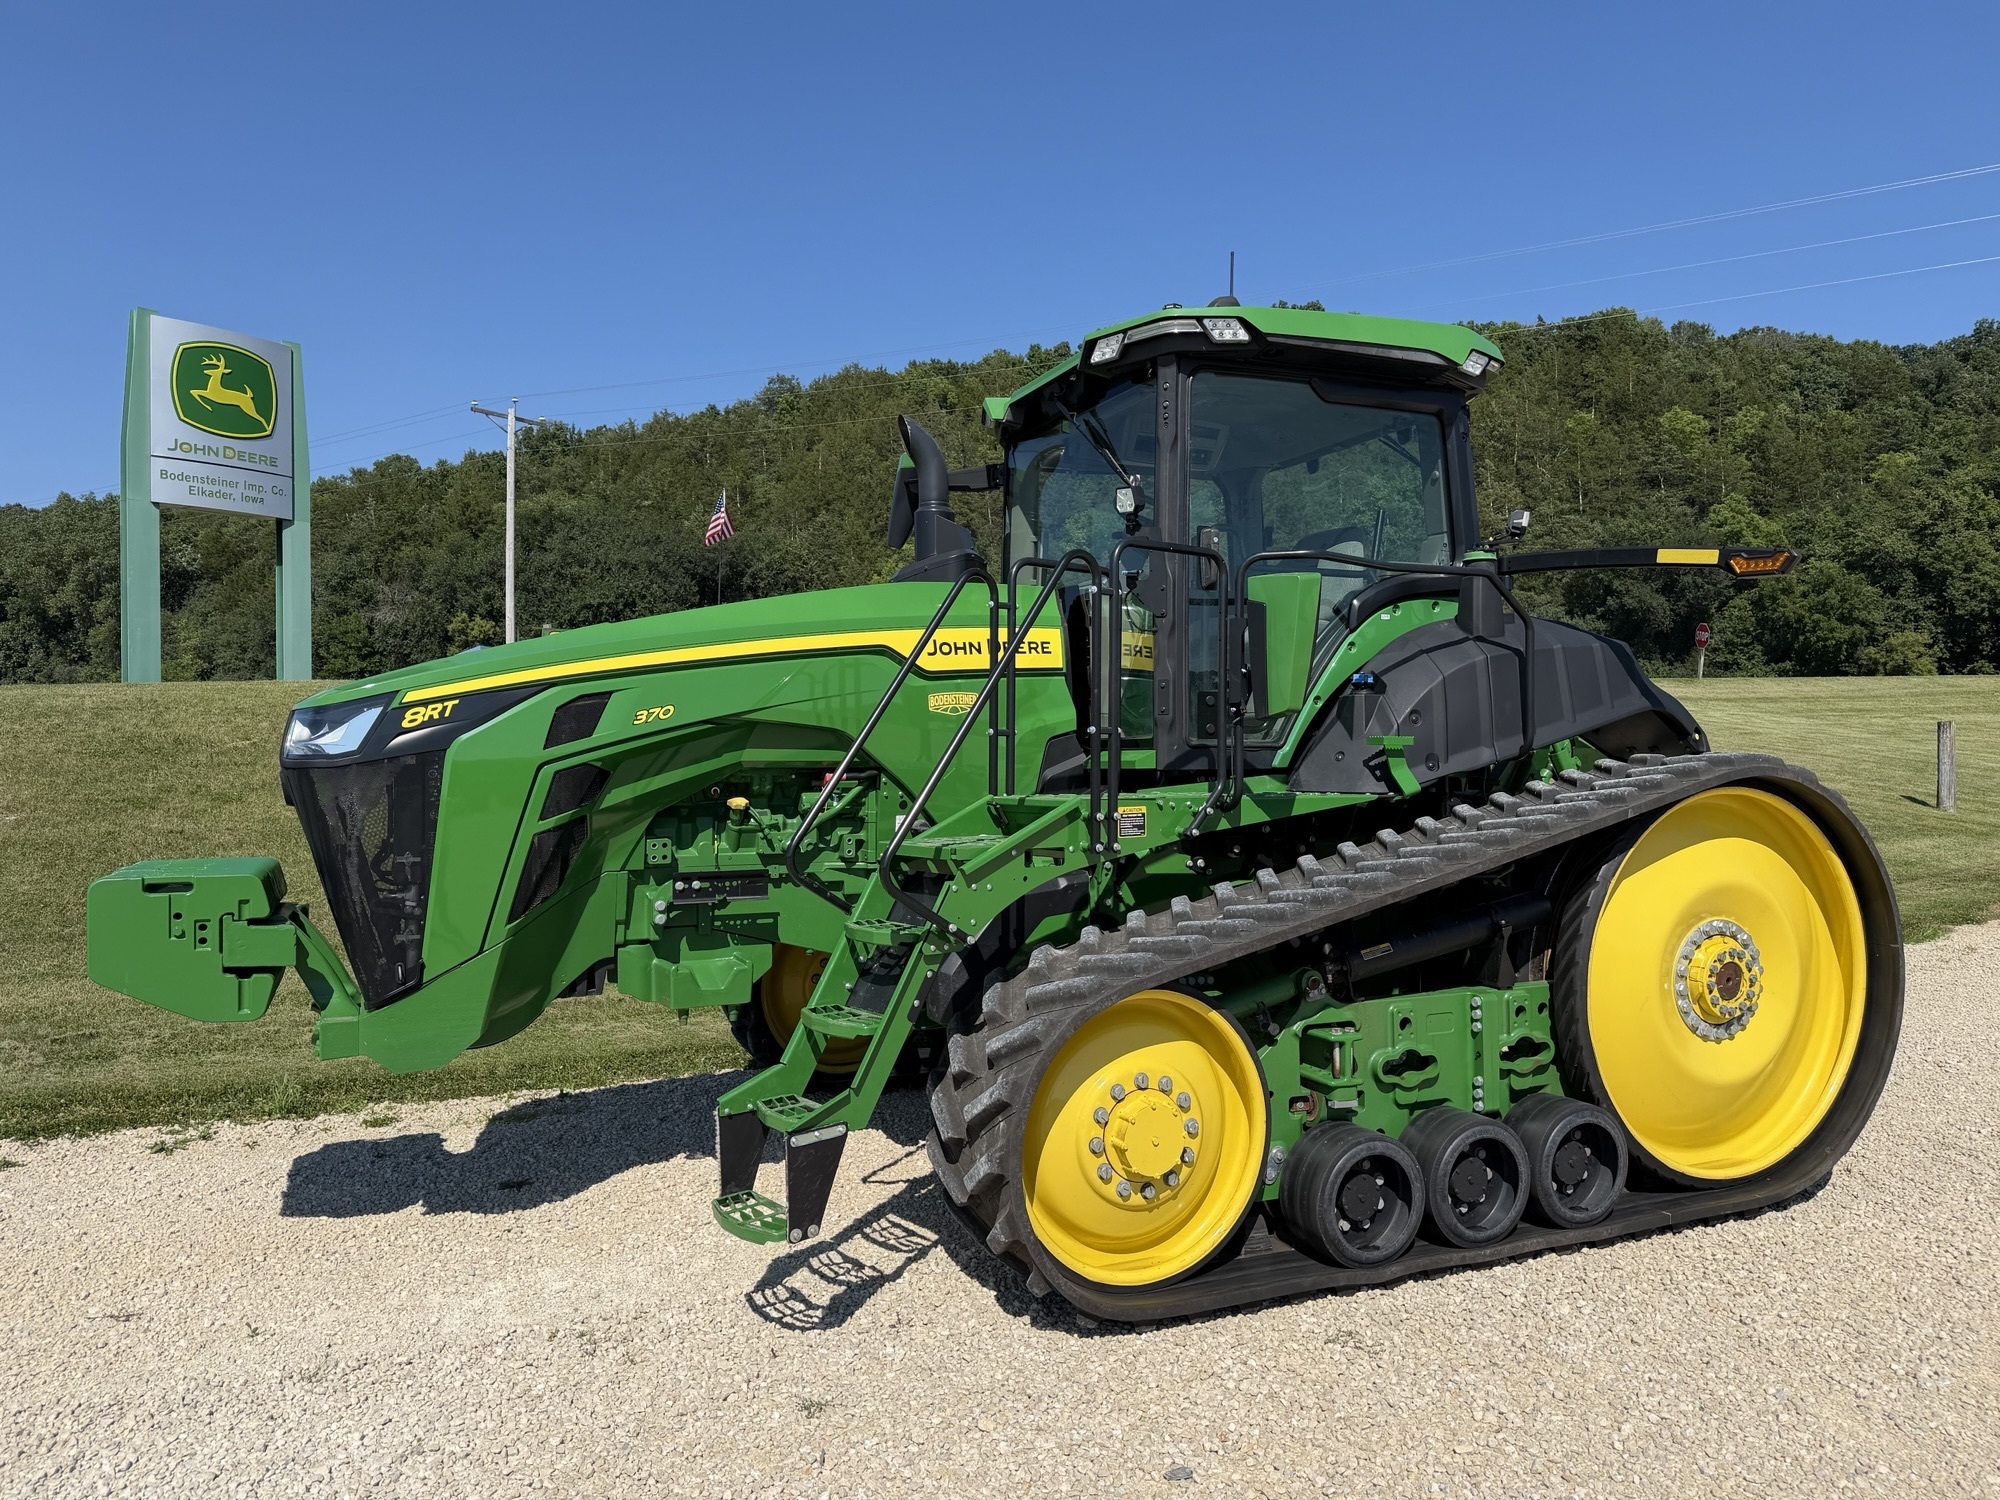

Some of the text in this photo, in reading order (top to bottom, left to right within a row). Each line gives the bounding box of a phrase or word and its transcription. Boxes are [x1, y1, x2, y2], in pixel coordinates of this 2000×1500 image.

[168, 438, 279, 468] JOHN DEERE
[160, 469, 287, 497] Bodensteiner Imp. Co.
[188, 485, 265, 505] Elkader, Iowa
[1696, 631, 1709, 641] STOP
[927, 639, 1051, 656] JOHN ERE
[401, 699, 460, 729] 8RT
[633, 705, 675, 726] 370
